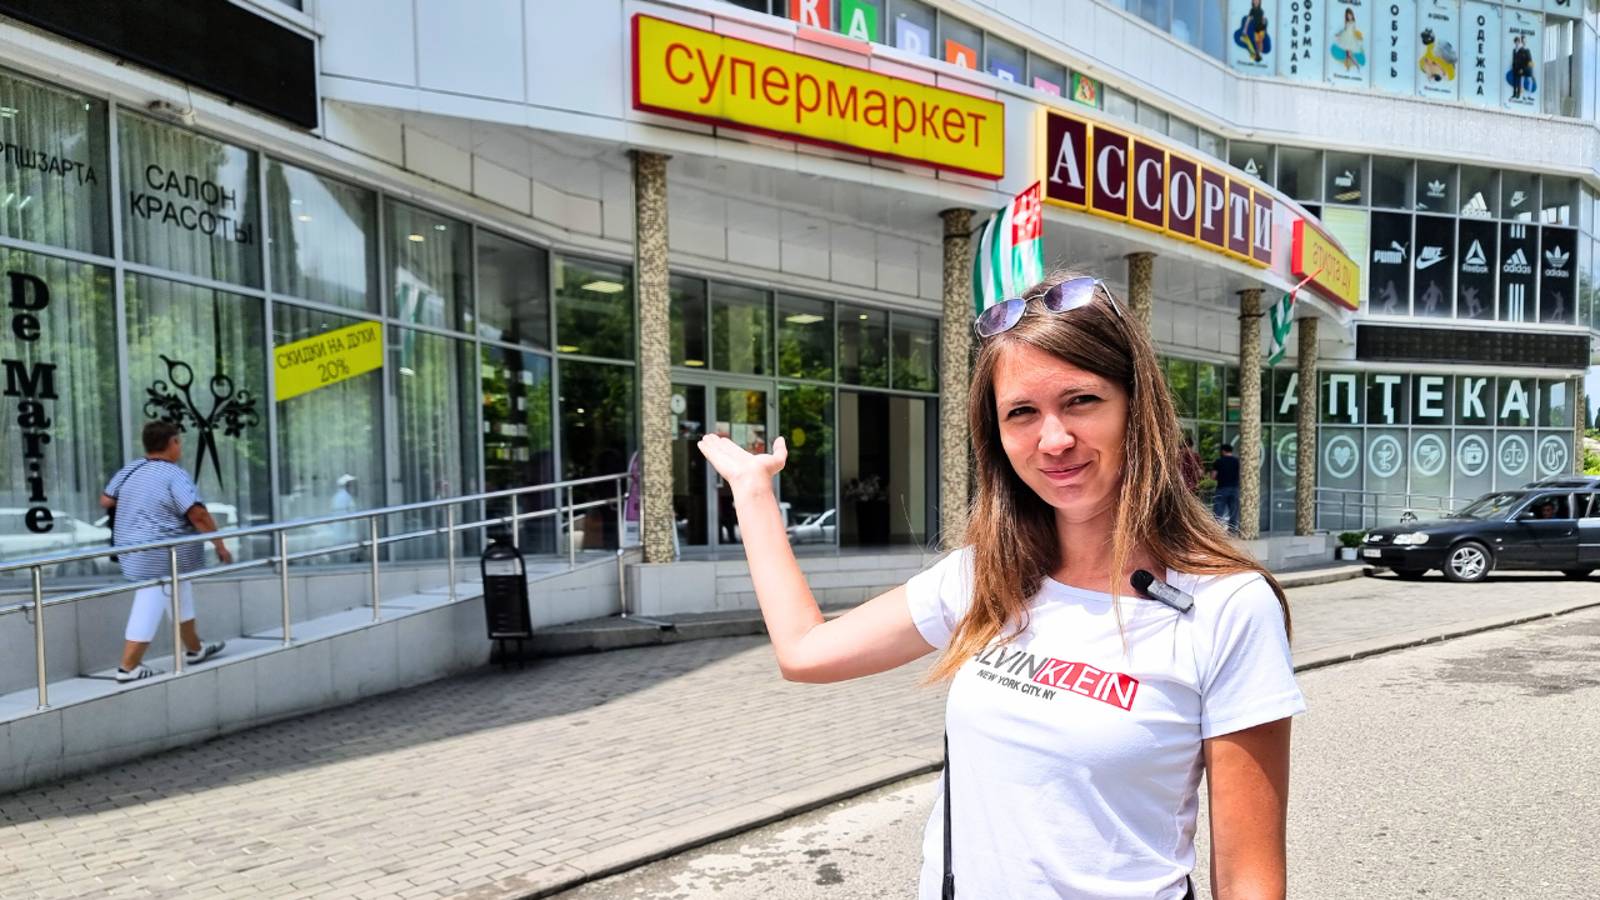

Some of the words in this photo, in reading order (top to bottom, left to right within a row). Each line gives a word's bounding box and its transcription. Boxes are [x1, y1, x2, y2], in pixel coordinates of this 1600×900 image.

[1390, 4, 1399, 78] ОБУВЬ
[1476, 15, 1486, 96] ОДЕЖДА
[664, 41, 987, 148] супермаркет
[145, 164, 236, 211] САЛОН
[1049, 131, 1273, 252] АССОРТИ
[129, 190, 253, 246] КРАСОТЫ
[1503, 263, 1532, 275] adidas
[1544, 268, 1570, 279] adidas
[7, 271, 50, 342] De
[276, 342, 327, 370] СКИДКИ
[326, 337, 346, 356] НА
[318, 359, 350, 383] 20%
[2, 359, 59, 534] Marie
[976, 668, 999, 683] NEW
[998, 675, 1021, 691] YORK
[1042, 688, 1056, 701] NY
[1035, 658, 1136, 710] KLEIN
